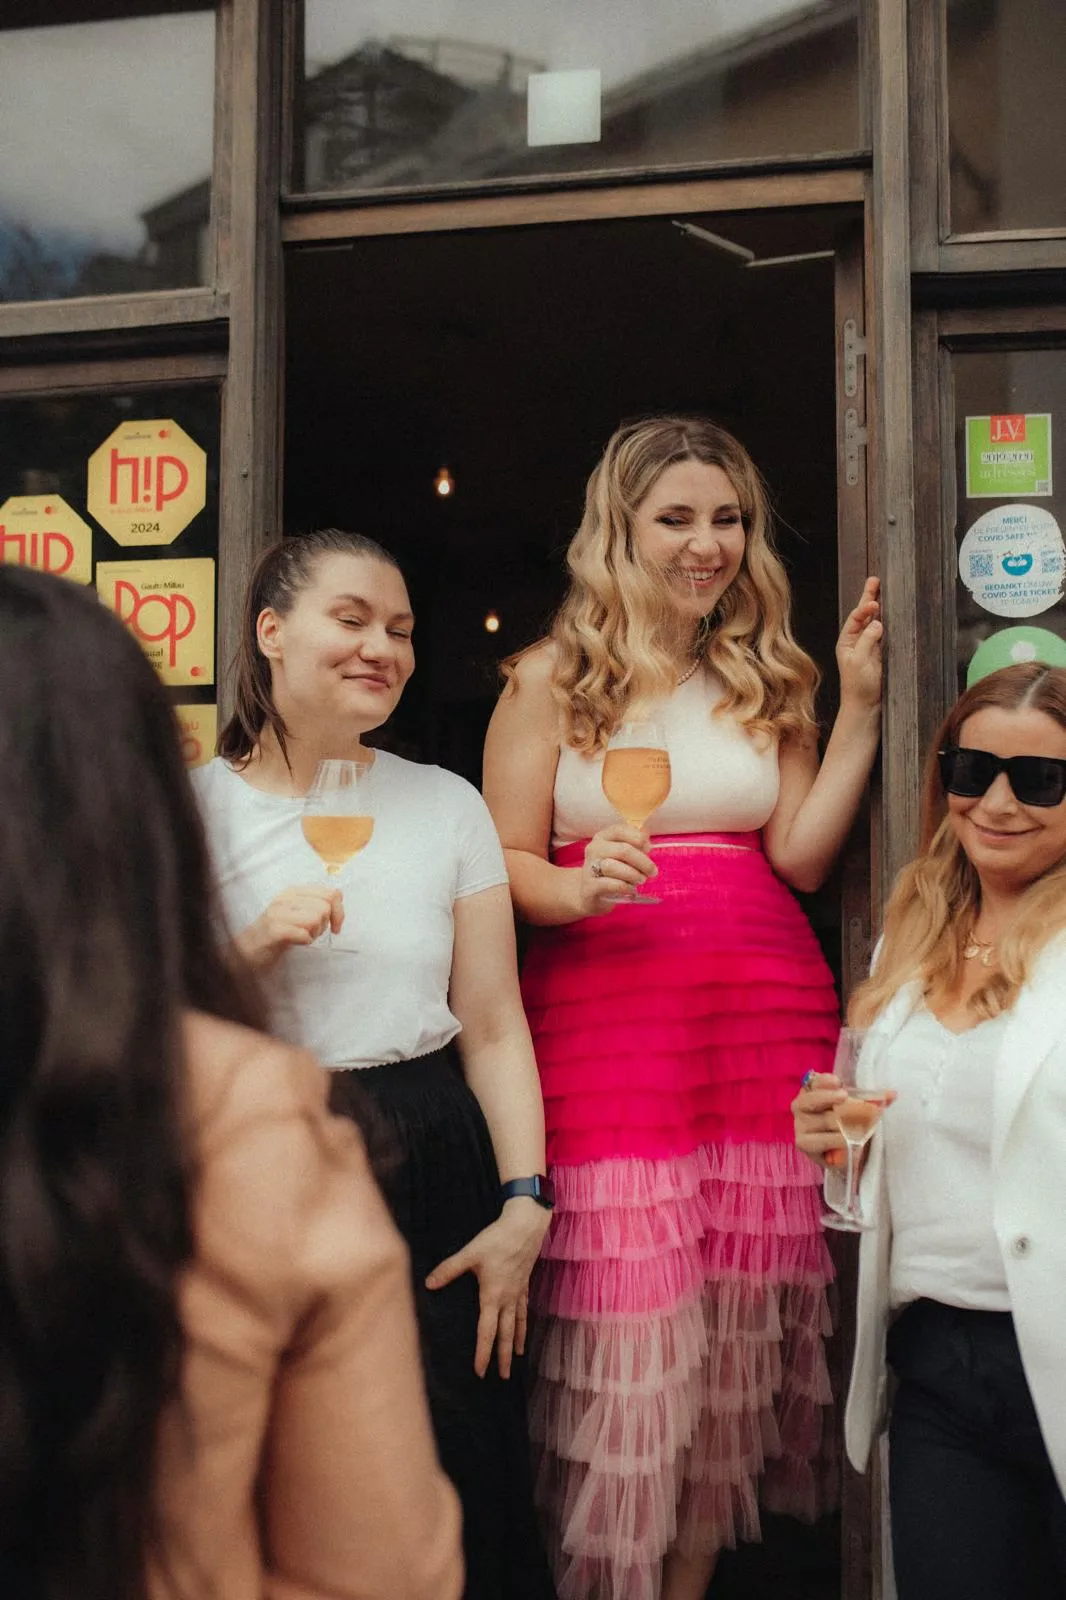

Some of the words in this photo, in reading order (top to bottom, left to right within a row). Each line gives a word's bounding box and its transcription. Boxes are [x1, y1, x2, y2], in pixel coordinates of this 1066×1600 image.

[130, 522, 161, 534] 2024
[977, 534, 1004, 542] COVID
[1005, 532, 1025, 540] SAFE
[984, 582, 1022, 592] BEDANKT
[981, 591, 1007, 600] COVID
[1008, 590, 1028, 598] SAFE
[1030, 588, 1057, 597] TICKET
